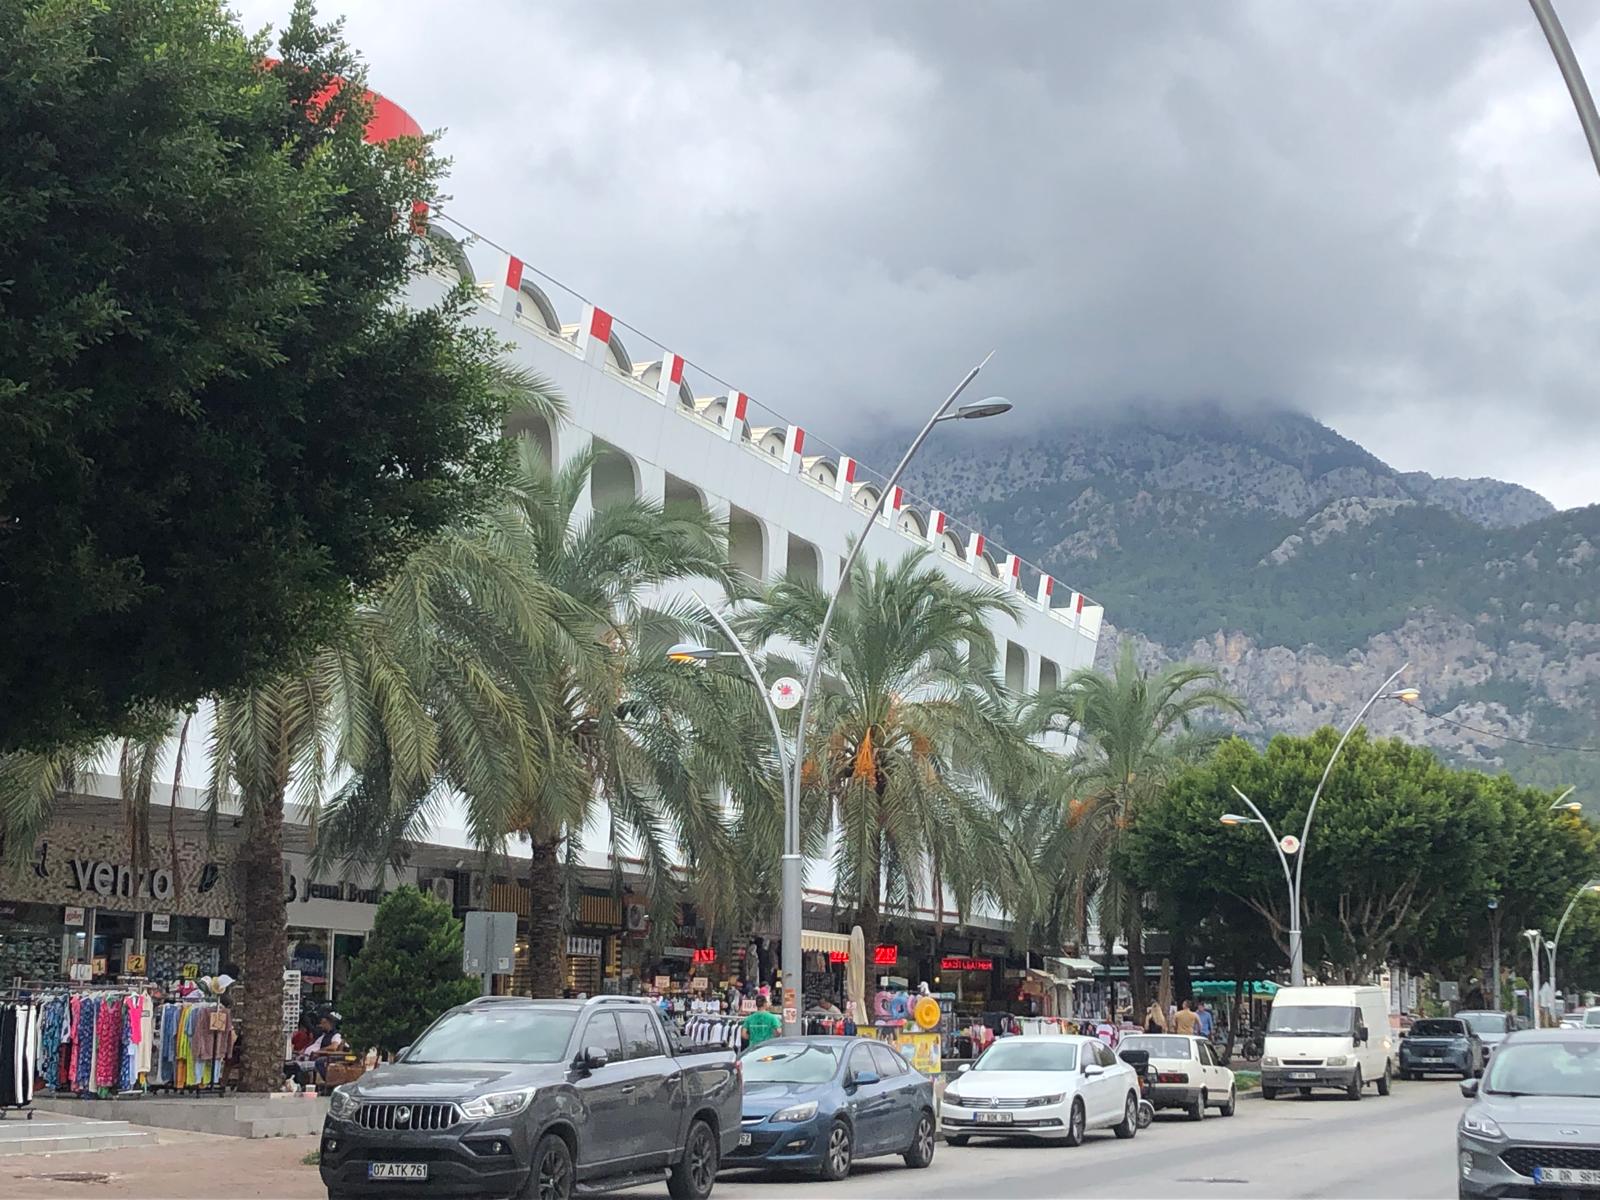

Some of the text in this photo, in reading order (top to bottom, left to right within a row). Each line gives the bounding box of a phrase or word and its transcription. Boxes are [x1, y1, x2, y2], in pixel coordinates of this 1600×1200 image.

[373, 1164, 427, 1177] 07 ATK 761
